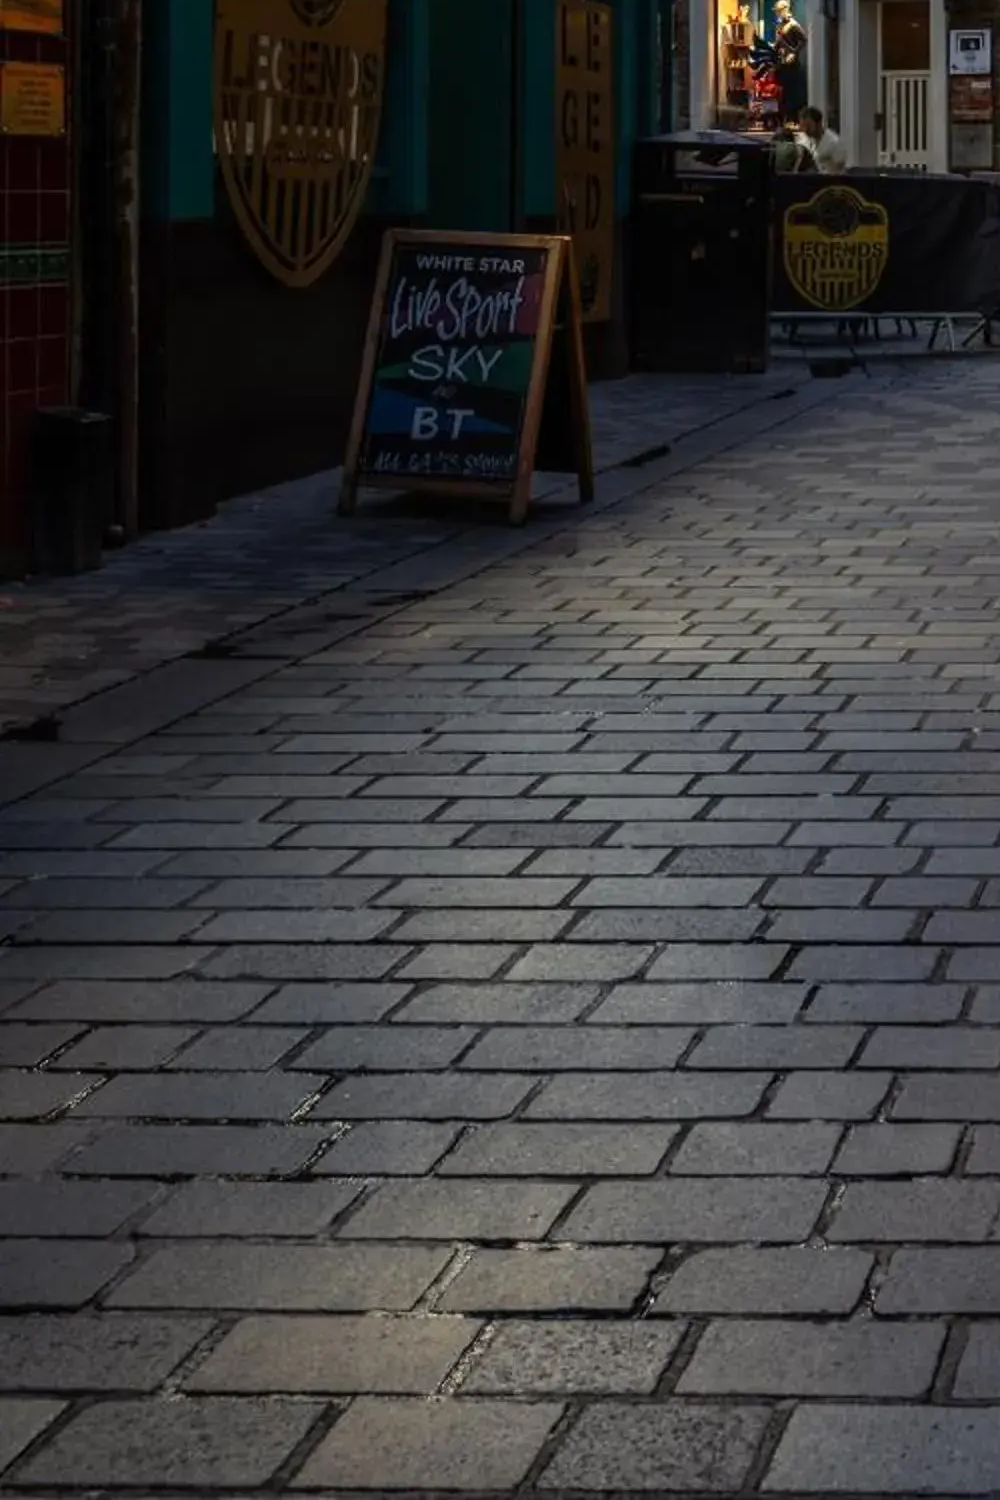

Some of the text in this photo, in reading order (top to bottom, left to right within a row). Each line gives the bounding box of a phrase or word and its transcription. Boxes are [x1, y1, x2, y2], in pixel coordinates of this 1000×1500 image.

[221, 29, 380, 105] LEGENDS
[416, 254, 526, 273] WHITE STAR
[787, 241, 883, 259] LEGENDS
[408, 344, 503, 383] SKY
